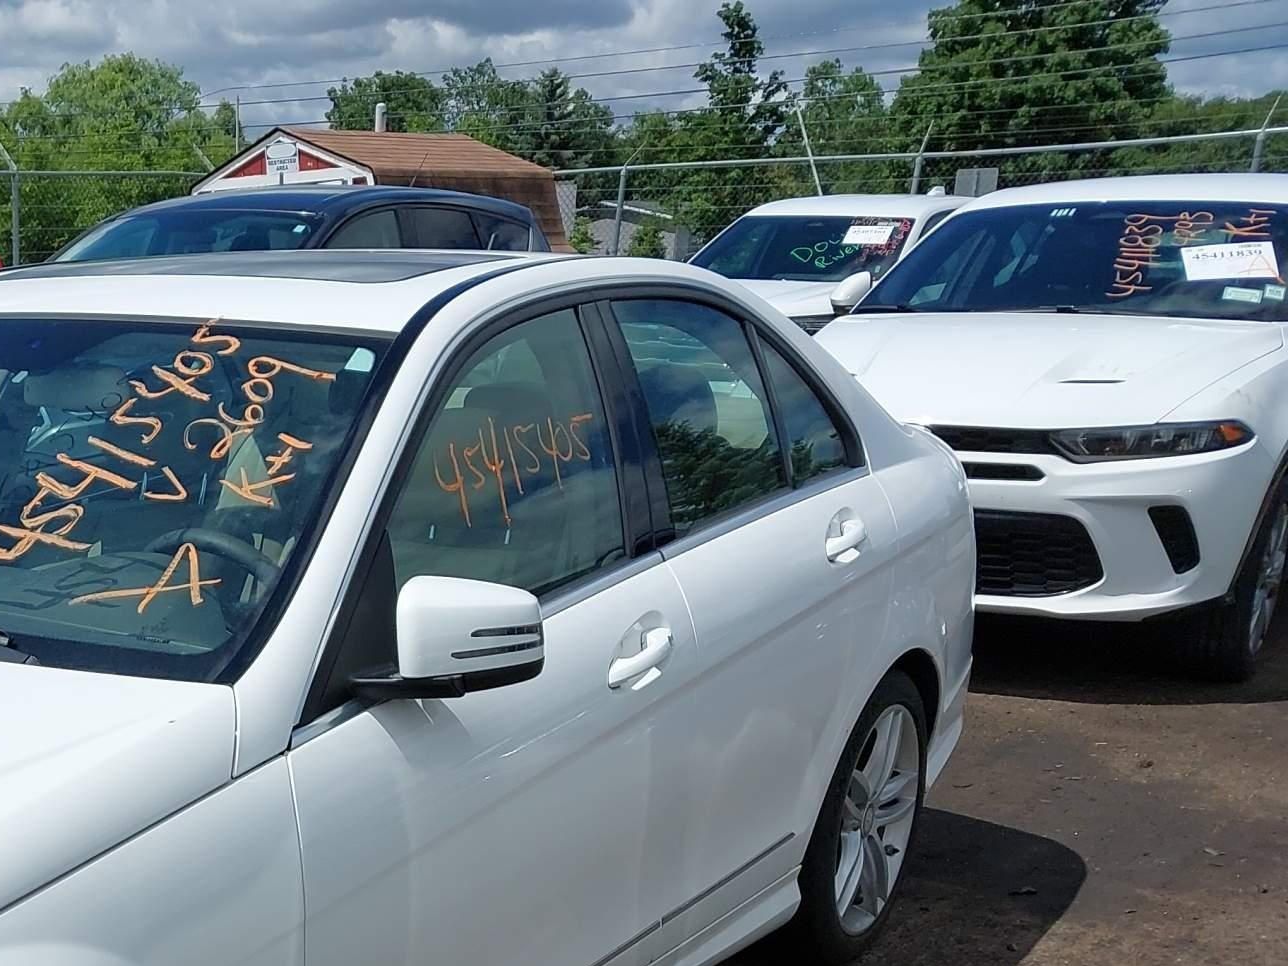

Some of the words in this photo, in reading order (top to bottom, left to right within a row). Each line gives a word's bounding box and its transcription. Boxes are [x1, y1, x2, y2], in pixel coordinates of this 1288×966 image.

[1104, 213, 1180, 297] 45411839
[182, 355, 338, 459] 2609
[432, 412, 593, 528] 45415405
